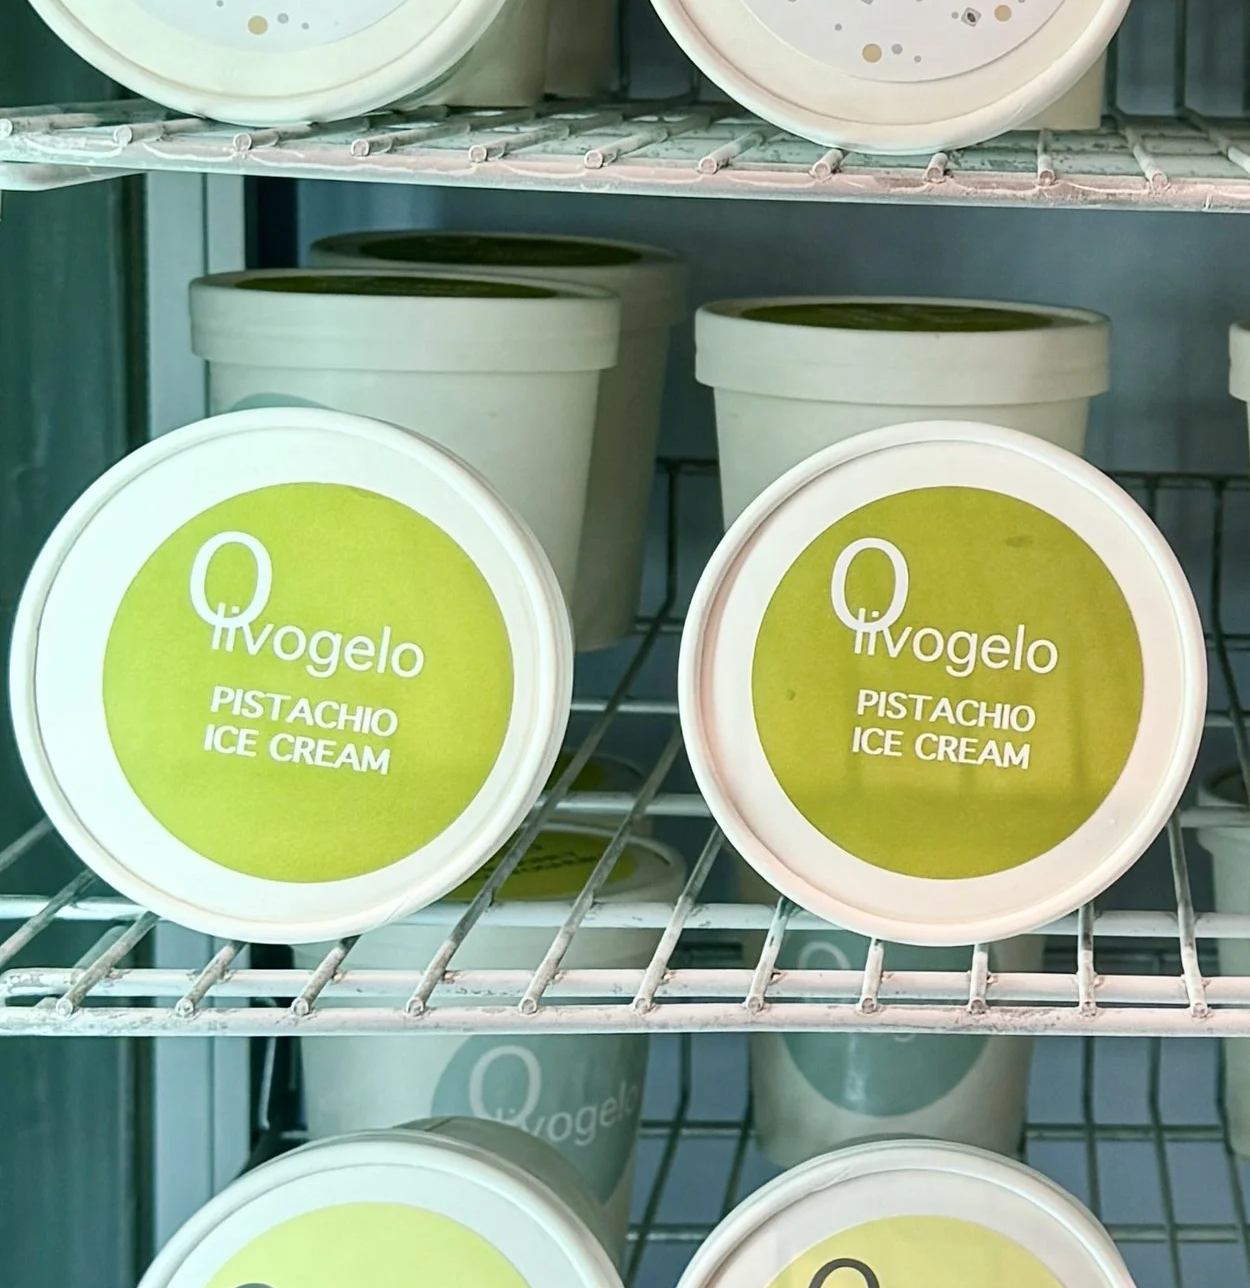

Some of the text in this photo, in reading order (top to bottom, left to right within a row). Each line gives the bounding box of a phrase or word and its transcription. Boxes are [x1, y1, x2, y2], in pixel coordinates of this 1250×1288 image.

[211, 686, 399, 736] PISTACHIO
[856, 688, 1036, 732] PISTACHIO
[203, 724, 391, 775] ICE CREAM
[852, 725, 1031, 770] ICE CREAM
